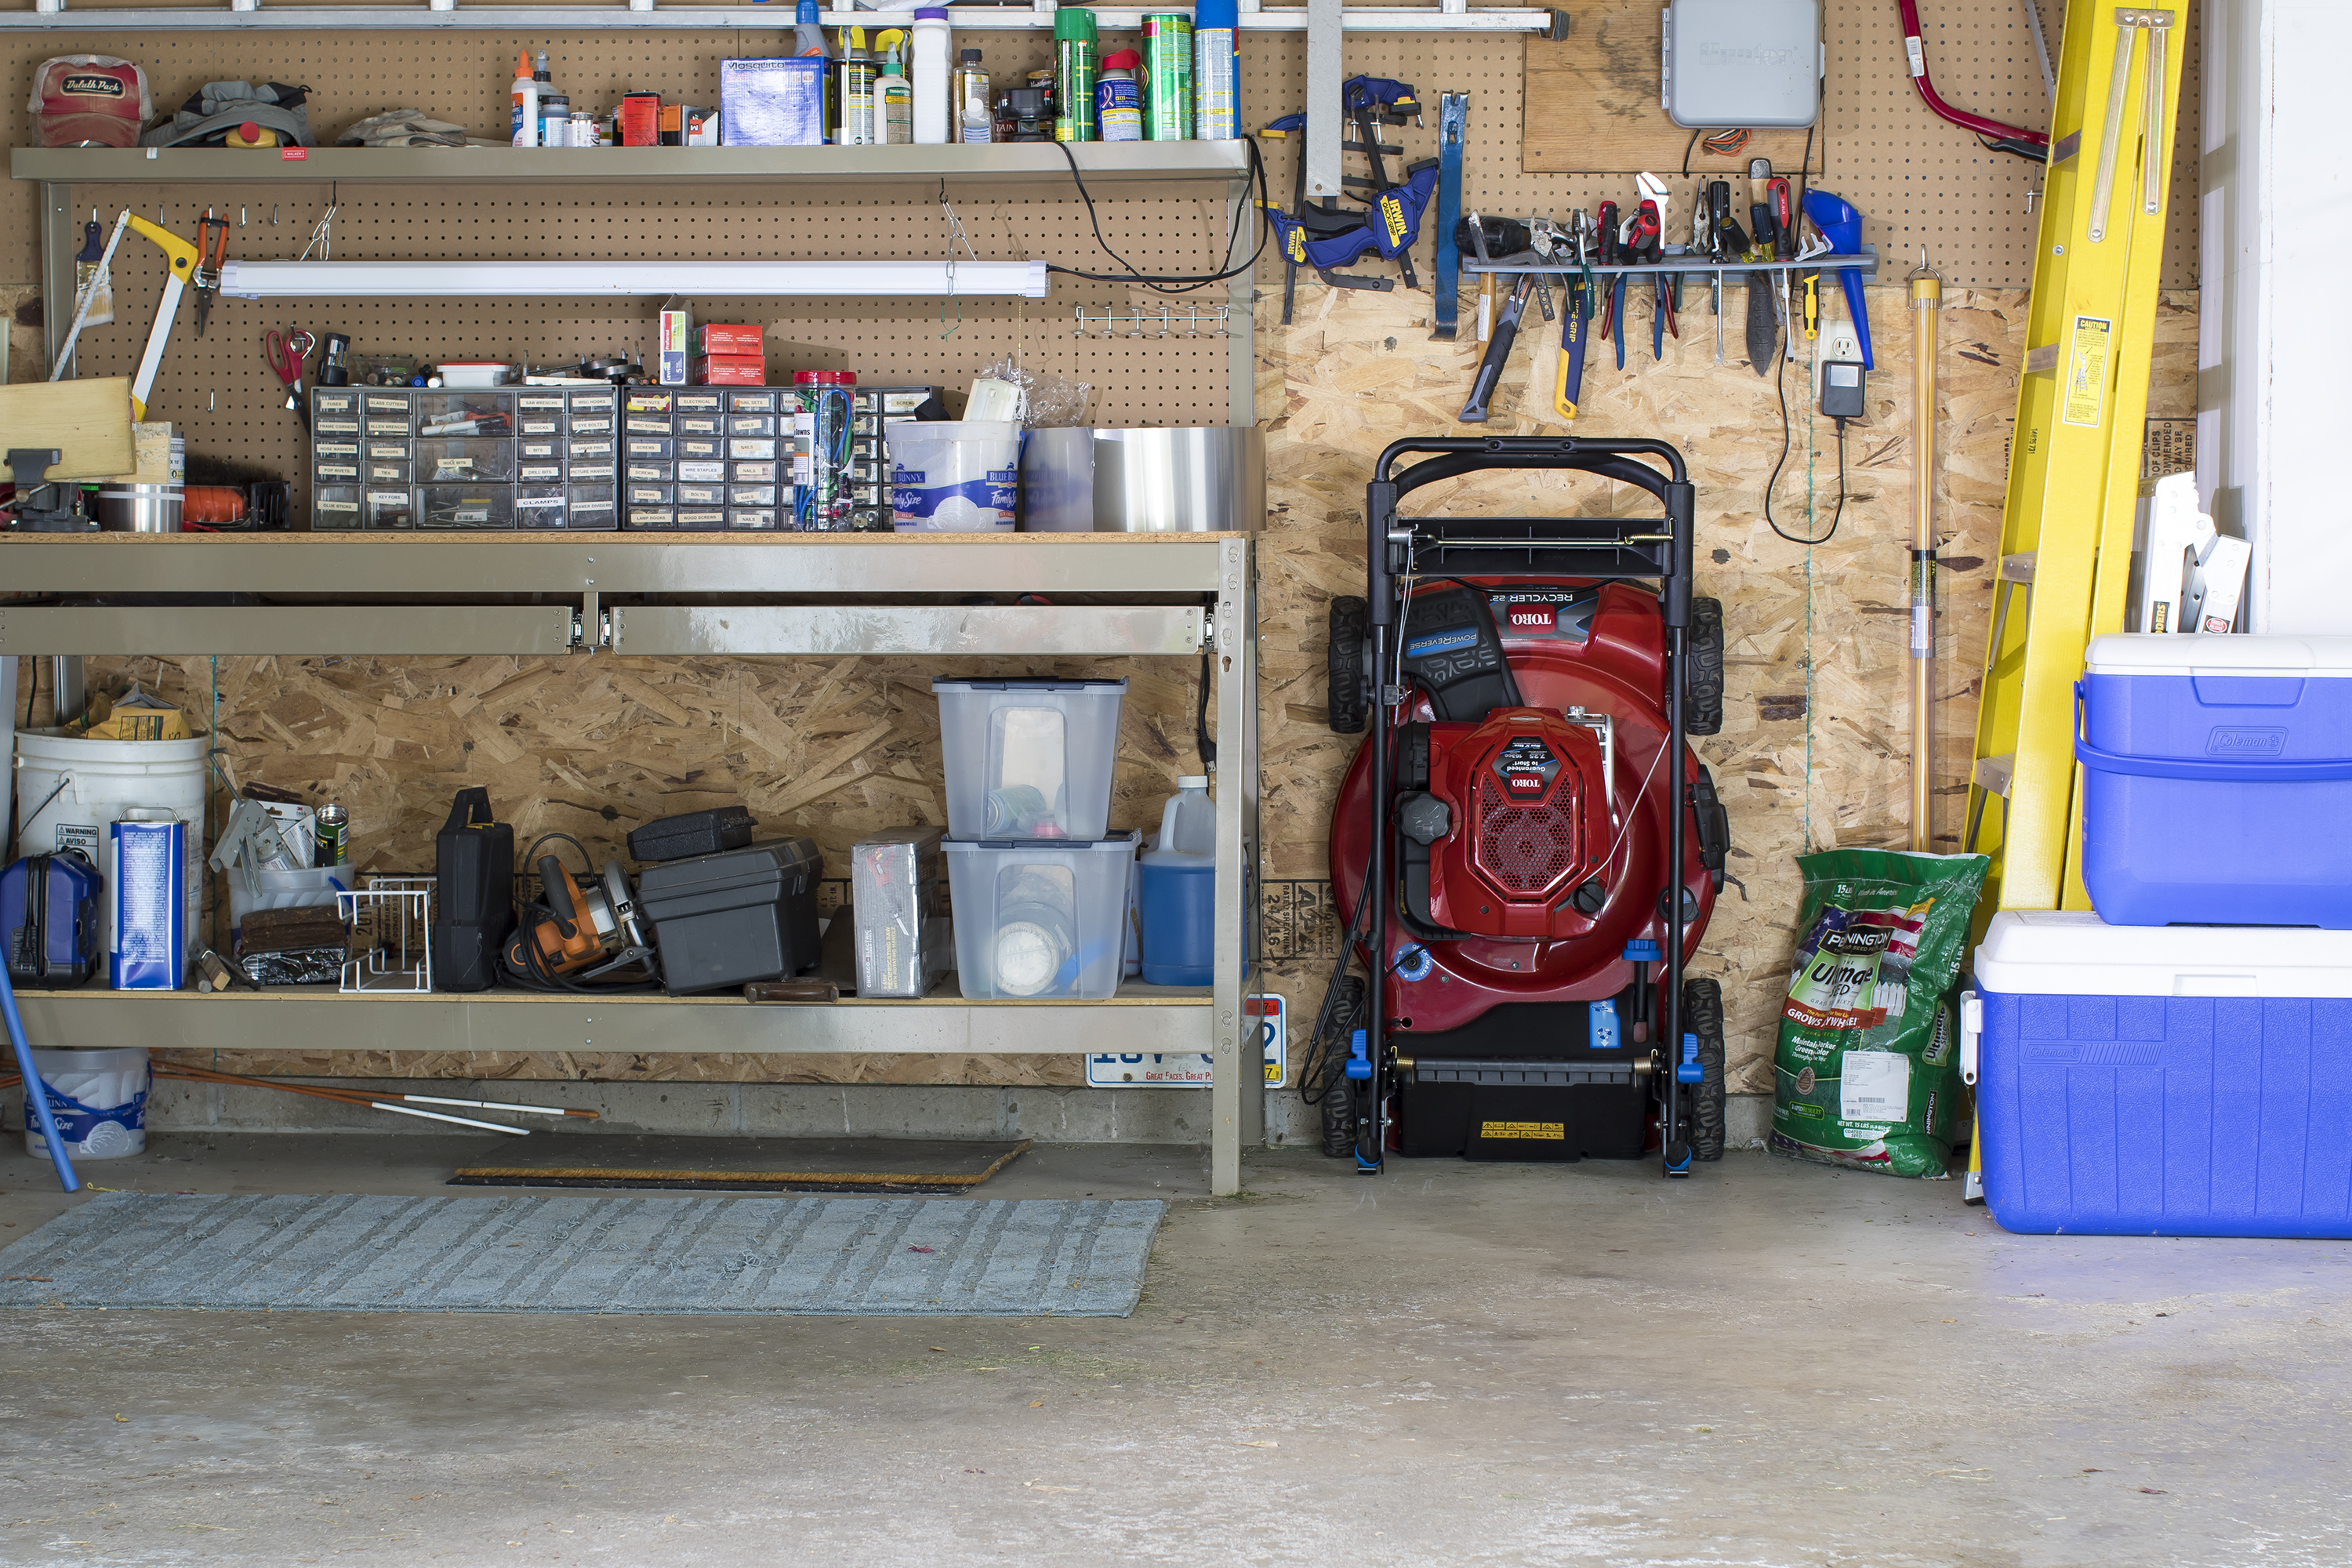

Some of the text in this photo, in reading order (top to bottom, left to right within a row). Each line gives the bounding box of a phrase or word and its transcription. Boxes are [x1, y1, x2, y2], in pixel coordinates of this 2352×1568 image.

[1700, 42, 1793, 66] Hunter
[66, 79, 119, 92] Duluth Pack
[995, 123, 1016, 132] TAIN
[1388, 198, 1408, 237] IRWIN
[1287, 230, 1297, 255] IRWIN
[2080, 319, 2107, 330] CAUTION
[2152, 430, 2161, 458] CLIPS
[2163, 422, 2172, 474] OMMENDED
[989, 472, 1007, 481] BLUE
[903, 492, 922, 508] Size
[991, 489, 1013, 508] Family
[1509, 593, 1573, 602] RECYCLER
[1512, 613, 1552, 626] TORO
[2218, 733, 2267, 747] Coleman
[1512, 779, 1540, 787] TORO
[64, 827, 97, 836] WARNING
[1837, 884, 1846, 894] 15
[1298, 884, 1317, 952] APA
[1950, 945, 1965, 975] 15 LBS
[1787, 1008, 1823, 1027] GROWS
[1926, 1005, 1946, 1059] Ultimate
[2029, 1045, 2069, 1058] Coleman
[1145, 1071, 1163, 1080] GREAT
[1185, 1071, 1203, 1080] GREAT
[55, 1117, 74, 1131] Size
